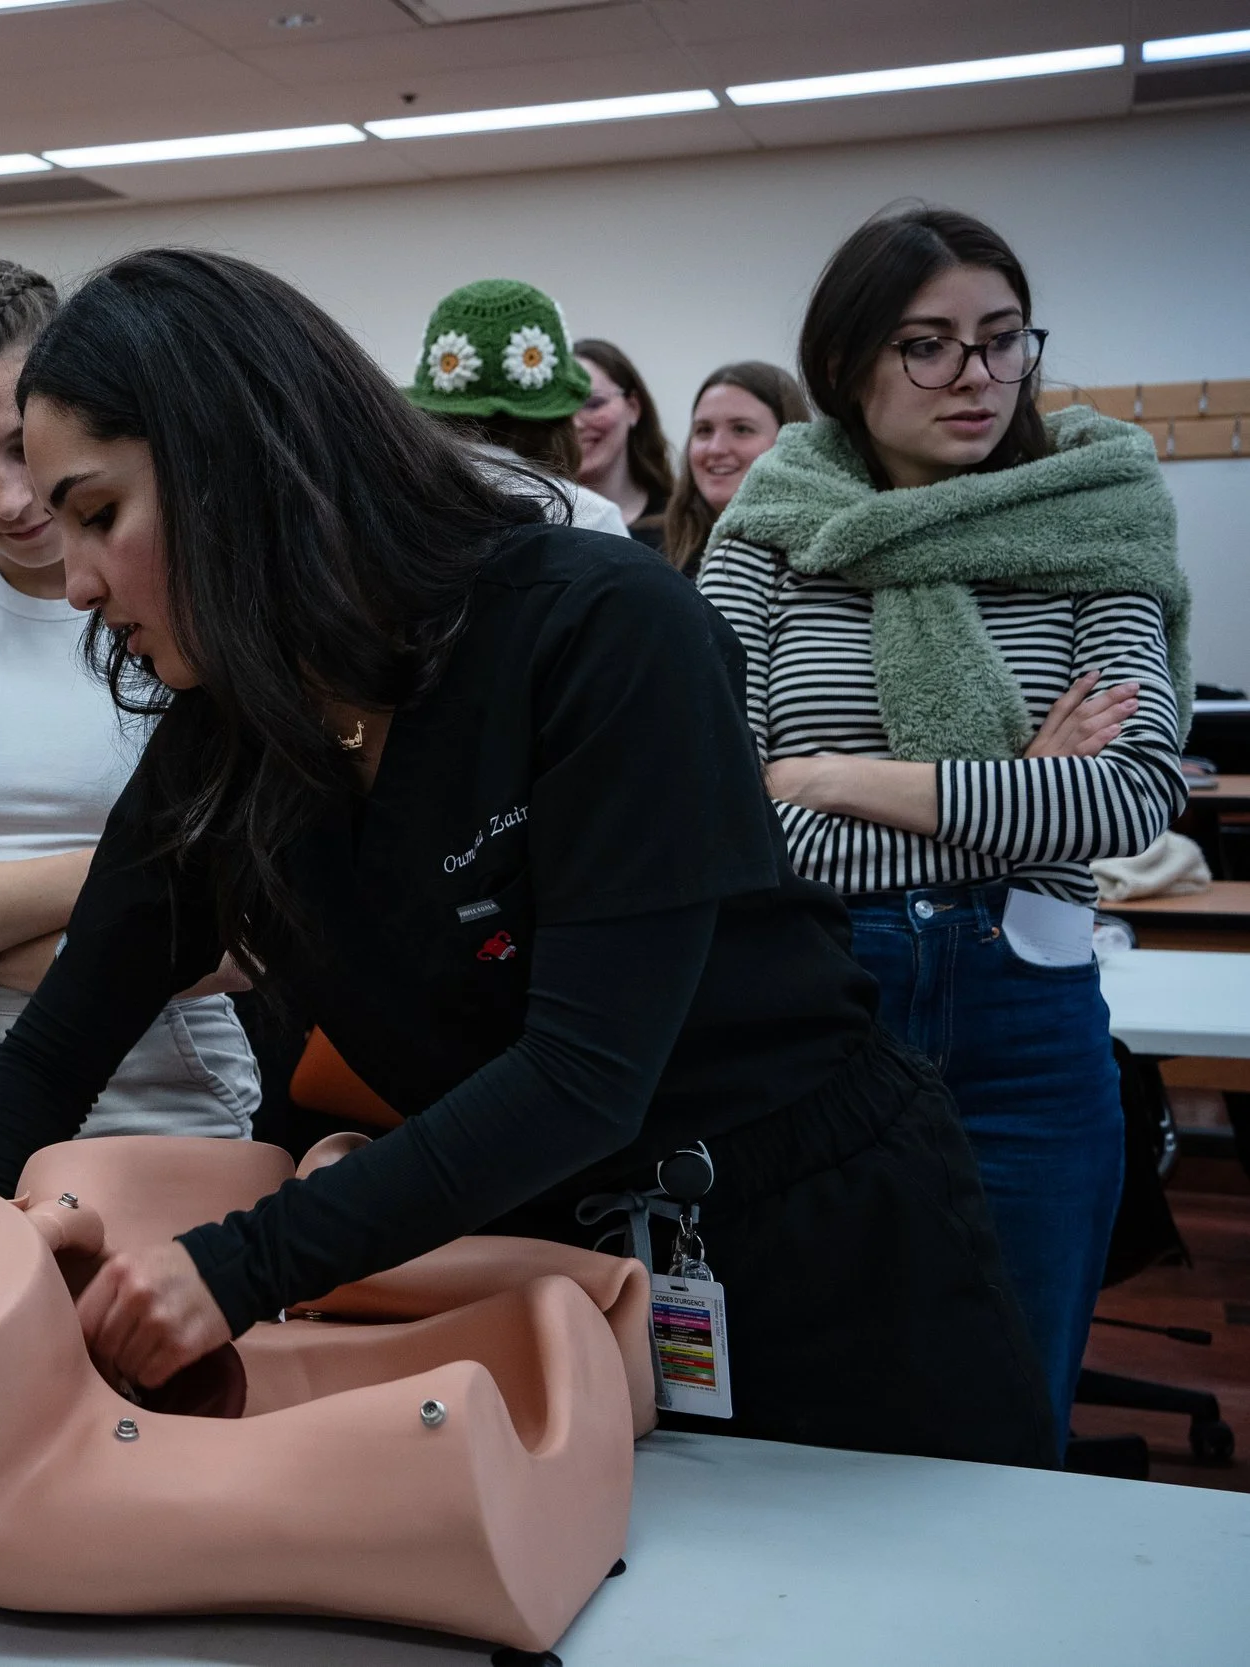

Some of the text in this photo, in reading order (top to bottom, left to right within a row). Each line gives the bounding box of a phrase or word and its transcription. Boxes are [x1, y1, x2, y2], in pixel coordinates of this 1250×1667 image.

[477, 903, 496, 912] KOALA
[655, 1294, 706, 1308] CODES D'URGENCE
